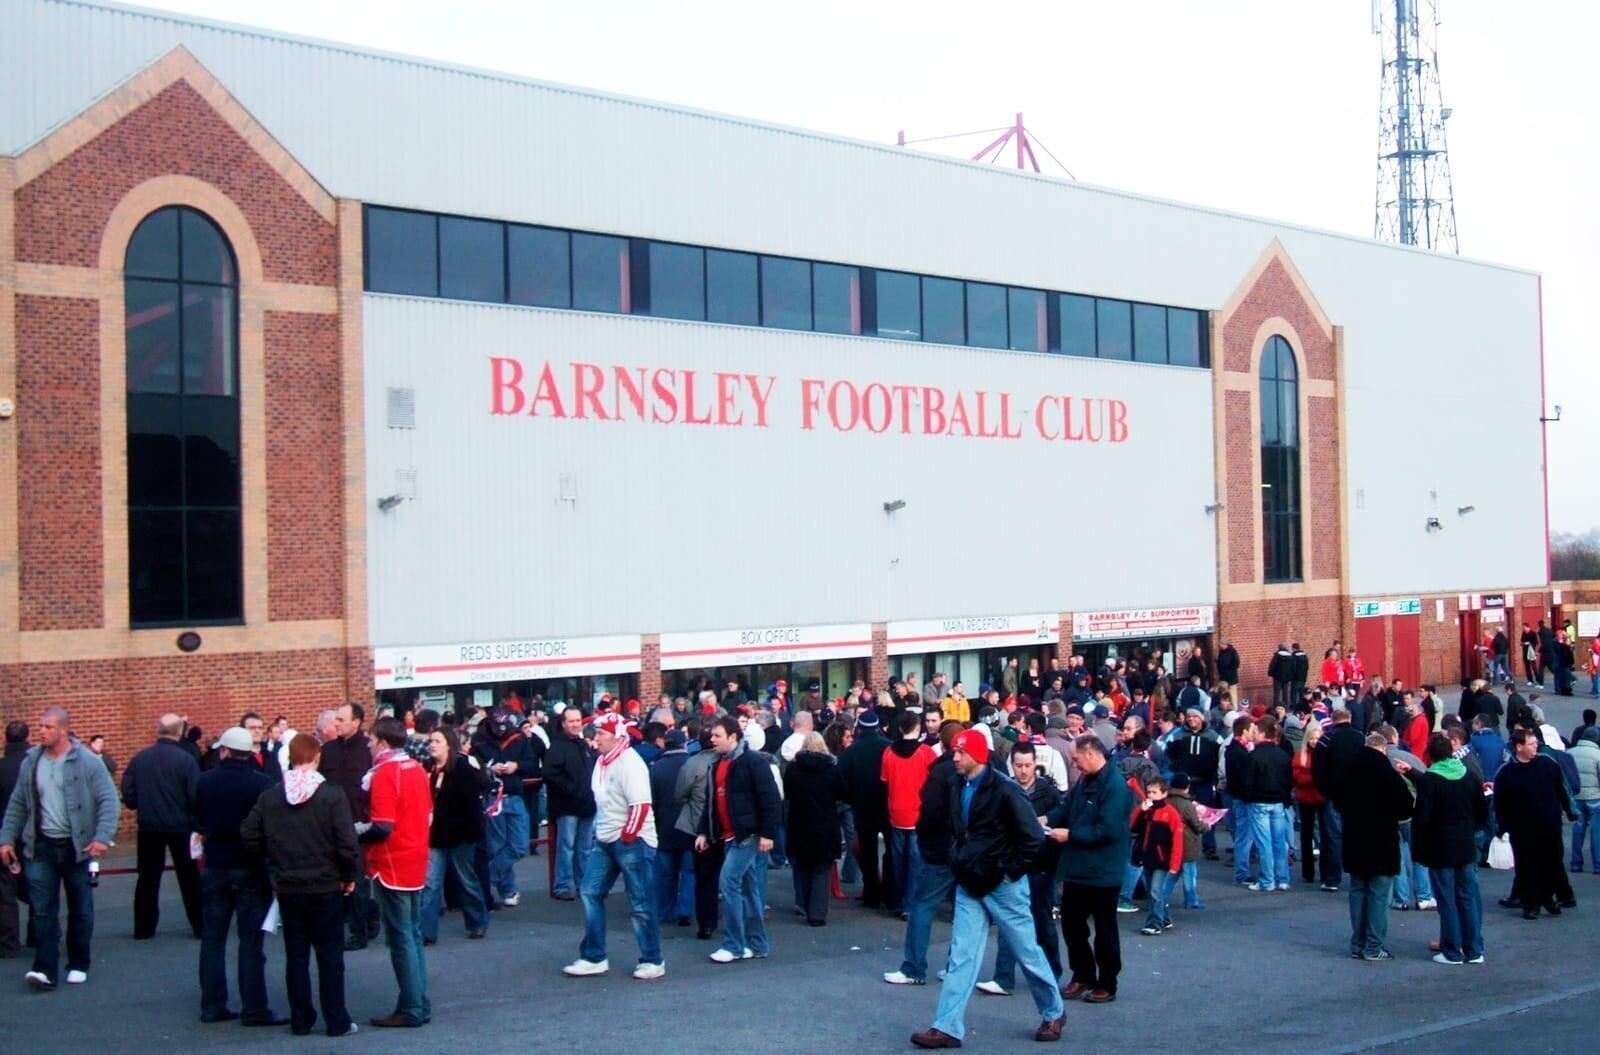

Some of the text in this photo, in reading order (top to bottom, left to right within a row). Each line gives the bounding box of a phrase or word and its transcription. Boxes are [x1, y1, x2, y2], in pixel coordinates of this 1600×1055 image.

[488, 356, 1129, 443] BARNSLEY FOOTBALL CLUB
[1088, 612, 1130, 621] BARNSLEY
[1150, 608, 1200, 618] SUPPORTERS
[943, 616, 1009, 633] MAIN RECEPTION
[741, 628, 800, 645] BOX OFFICE
[460, 641, 568, 661] REDS SUPERSTORE
